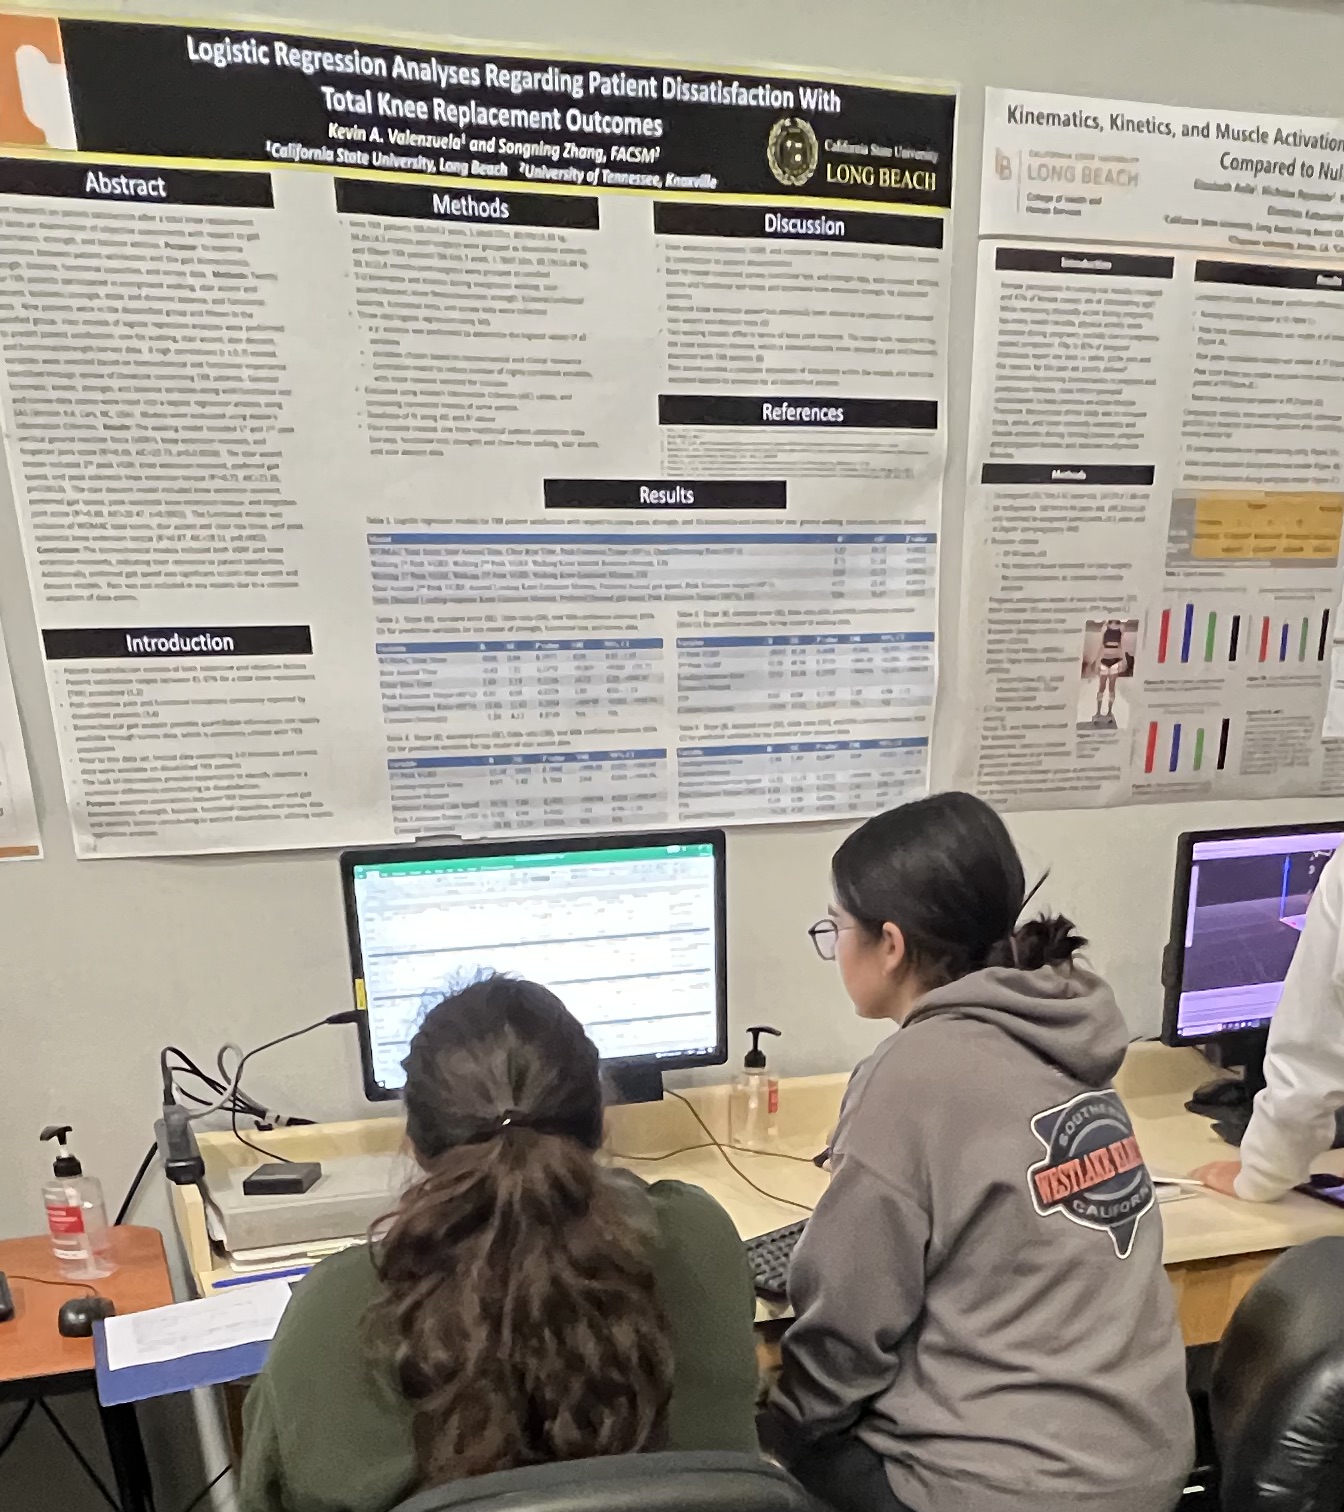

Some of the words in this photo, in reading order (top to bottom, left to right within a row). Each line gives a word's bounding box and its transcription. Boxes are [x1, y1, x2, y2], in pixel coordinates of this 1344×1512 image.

[186, 34, 270, 69] Logistic
[274, 41, 387, 78] Regression
[393, 54, 481, 88] Analyses
[486, 62, 584, 100] Regarding
[587, 71, 658, 99] Patient
[663, 77, 794, 110] Dissatisfaction
[799, 87, 841, 114] With
[321, 85, 374, 114] Total
[379, 92, 428, 121] Knee
[434, 97, 561, 132] Replacement
[567, 108, 664, 138] Outcomes
[1007, 104, 1104, 133] Kinematics,
[1109, 112, 1176, 138] Kinetics,
[1182, 120, 1210, 140] and
[1215, 121, 1269, 146] Muscle
[328, 122, 366, 143] Kevin
[370, 126, 385, 144] A.
[469, 136, 495, 154] and
[499, 138, 558, 162] Songning
[563, 143, 607, 165] Zhang,
[337, 148, 370, 165] State
[373, 150, 437, 173] University,
[440, 157, 468, 177] Long
[471, 159, 508, 177] Beach
[585, 167, 599, 185] of
[601, 169, 662, 189] Tennessee,
[665, 172, 717, 191] Knoxville
[826, 163, 875, 187] LONG
[879, 166, 937, 192] BEACH
[1027, 163, 1076, 184] LONG
[1081, 166, 1140, 188] BEACH
[1220, 151, 1295, 182] Compared
[1299, 160, 1315, 178] to
[85, 171, 167, 198] Abstract
[432, 194, 510, 219] Methods
[764, 213, 845, 237] Discussion
[762, 402, 844, 423] References
[640, 486, 695, 505] Results
[126, 632, 235, 654] Introduction
[1035, 1147, 1117, 1205] WESTLAKE
